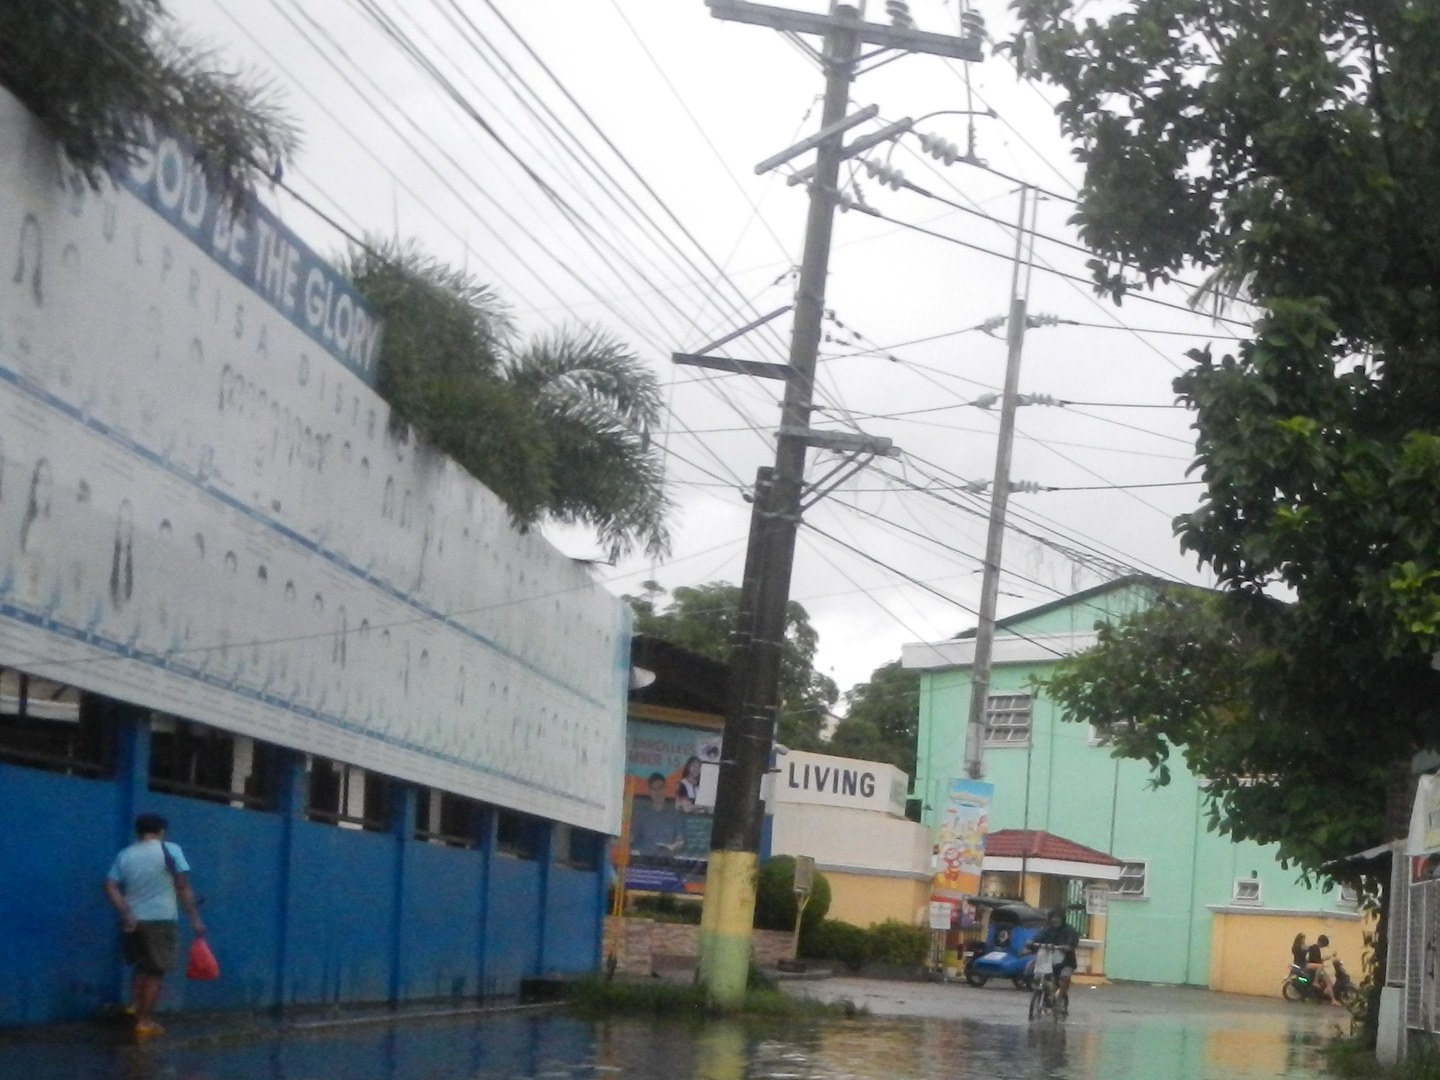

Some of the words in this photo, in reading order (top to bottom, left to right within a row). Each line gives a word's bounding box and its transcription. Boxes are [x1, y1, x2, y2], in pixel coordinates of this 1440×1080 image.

[255, 217, 300, 308] THE
[304, 266, 384, 372] GLORY
[789, 762, 875, 797] LIVING
